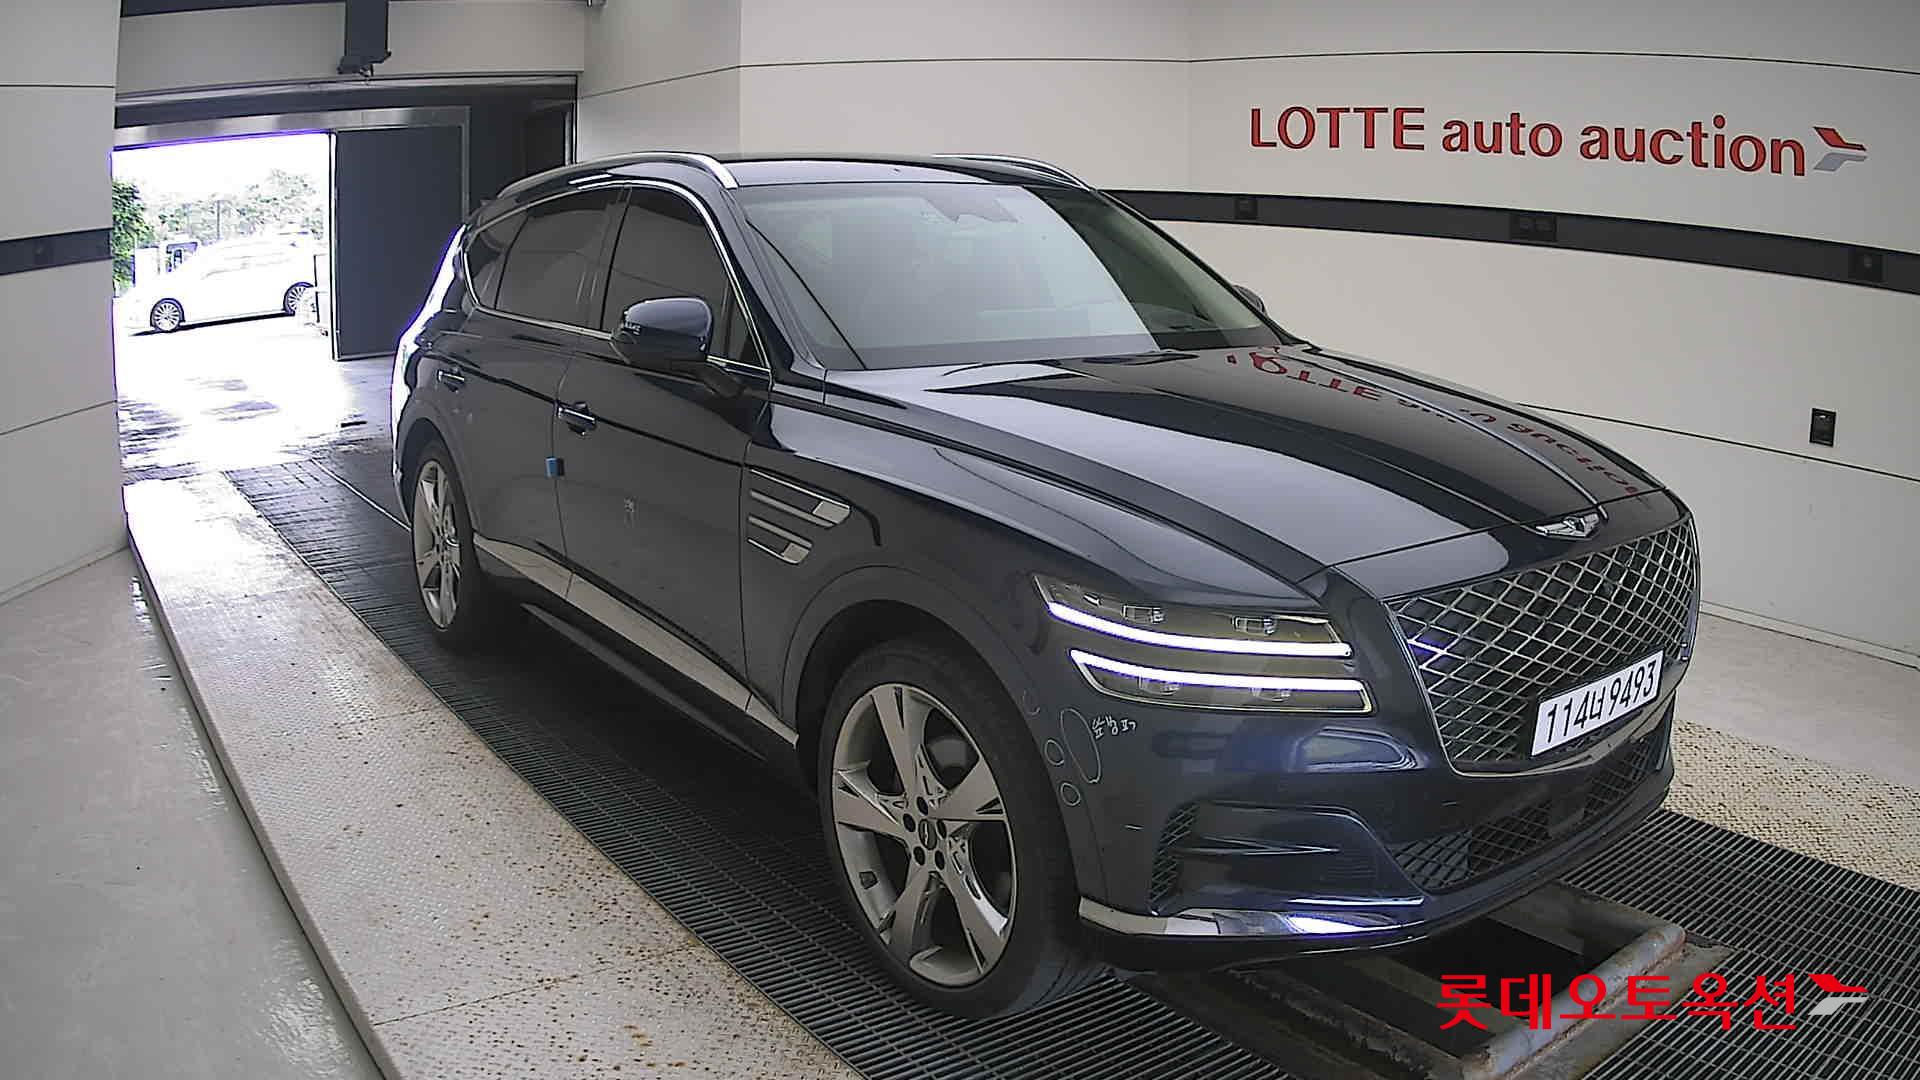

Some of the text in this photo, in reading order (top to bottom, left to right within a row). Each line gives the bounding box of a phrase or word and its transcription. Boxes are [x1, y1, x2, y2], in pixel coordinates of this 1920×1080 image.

[1250, 106, 1806, 177] LOTTE auto auction
